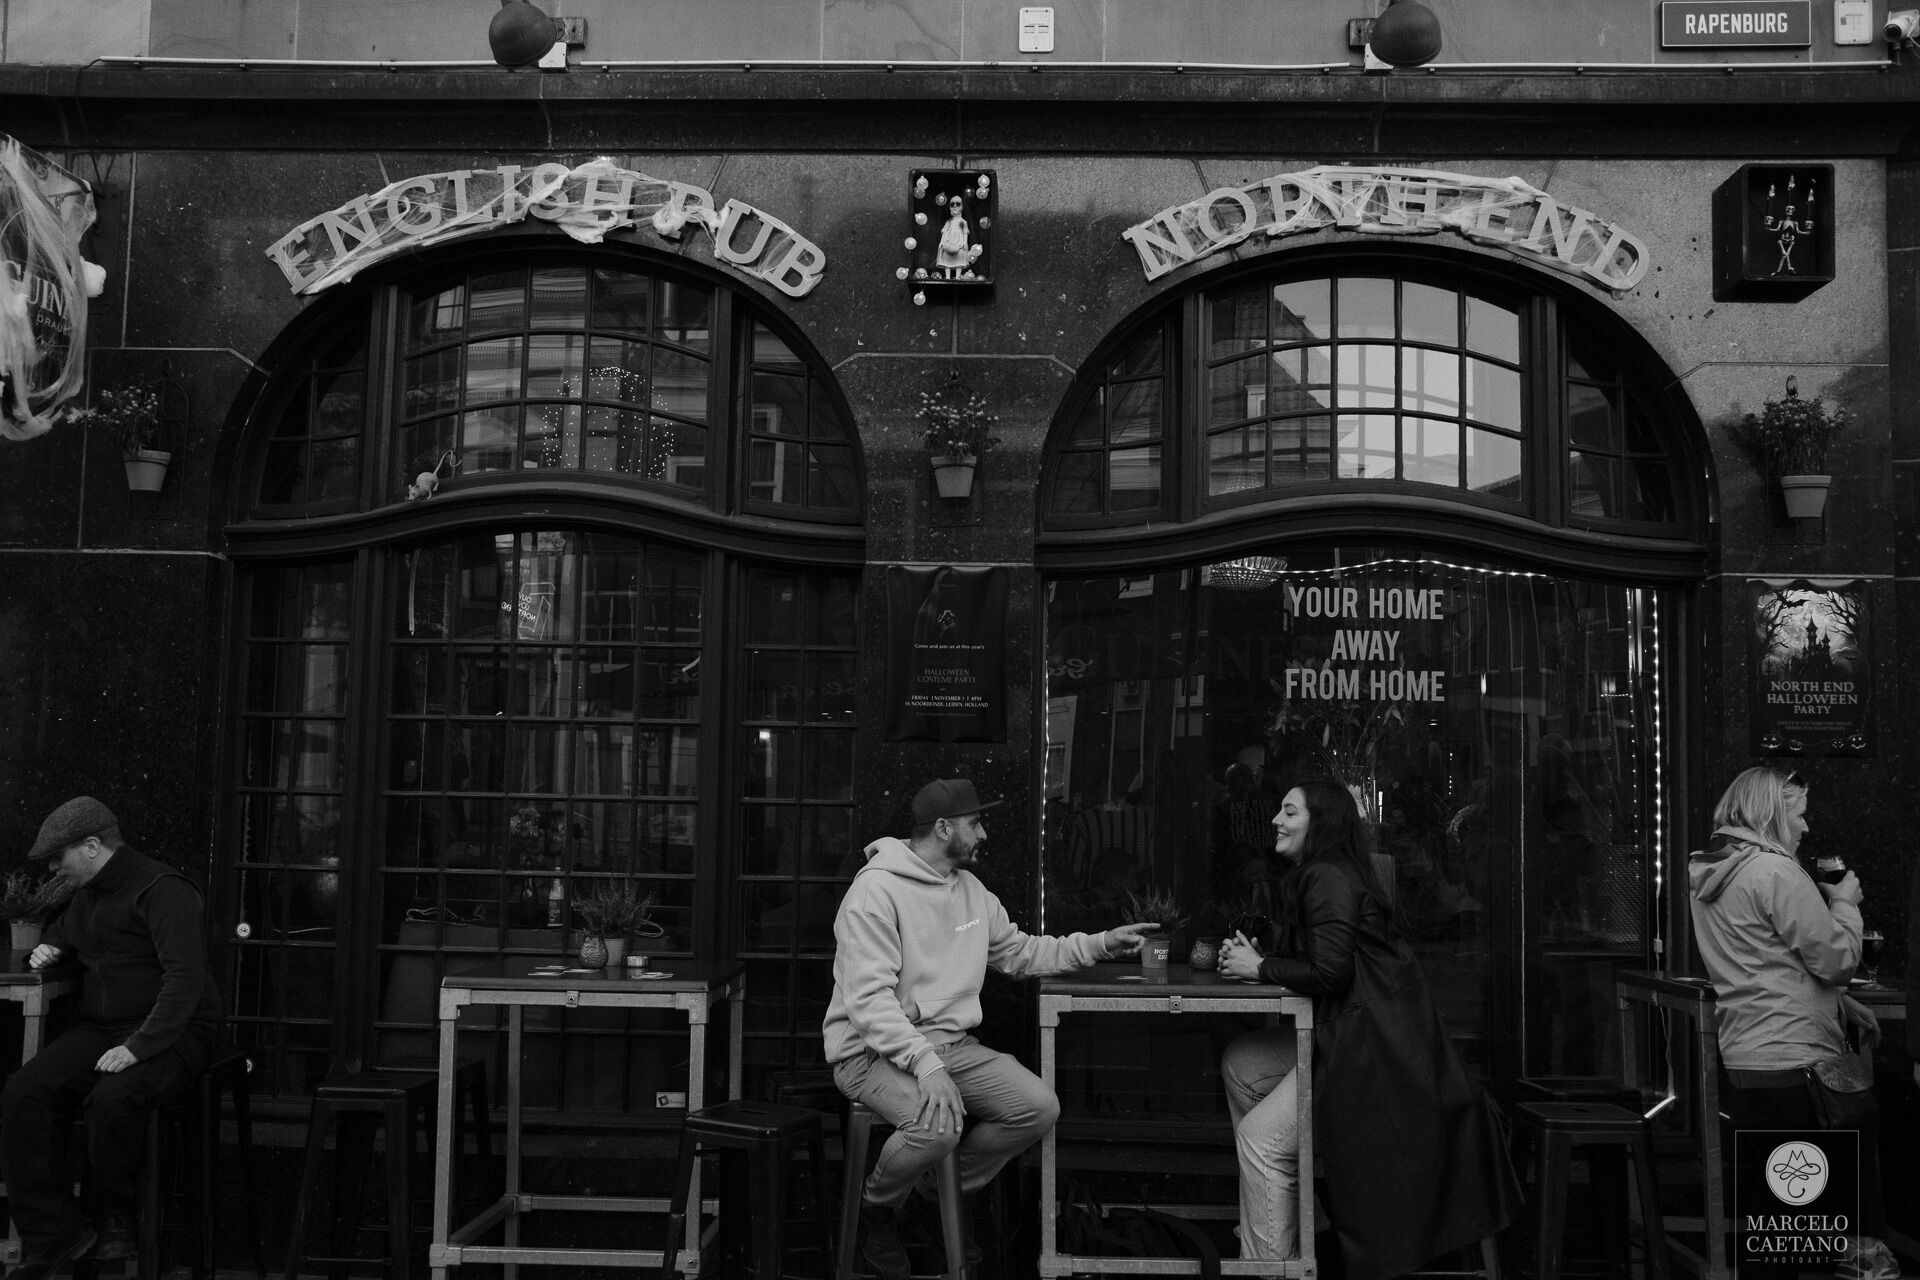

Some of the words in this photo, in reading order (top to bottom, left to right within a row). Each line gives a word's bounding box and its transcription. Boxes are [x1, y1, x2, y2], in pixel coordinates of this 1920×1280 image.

[1685, 13, 1788, 34] RAPENBURG
[266, 162, 637, 295] ENGLISH
[662, 180, 828, 297] PUB
[1123, 173, 1441, 281] NORTH
[1472, 189, 1650, 293] END
[1288, 586, 1359, 618] YOUR
[1369, 588, 1444, 620] HOME
[1331, 629, 1400, 661] AWAY
[917, 675, 953, 683] COSTUME
[955, 676, 977, 684] PARTY
[924, 668, 969, 676] HALLOWEEN
[1286, 668, 1360, 700] FROM
[1370, 669, 1445, 702] HOME
[1771, 681, 1819, 692] NORTH
[1823, 681, 1855, 693] END
[1767, 694, 1858, 704] HALLOWEEN
[1794, 705, 1832, 714] PARTY
